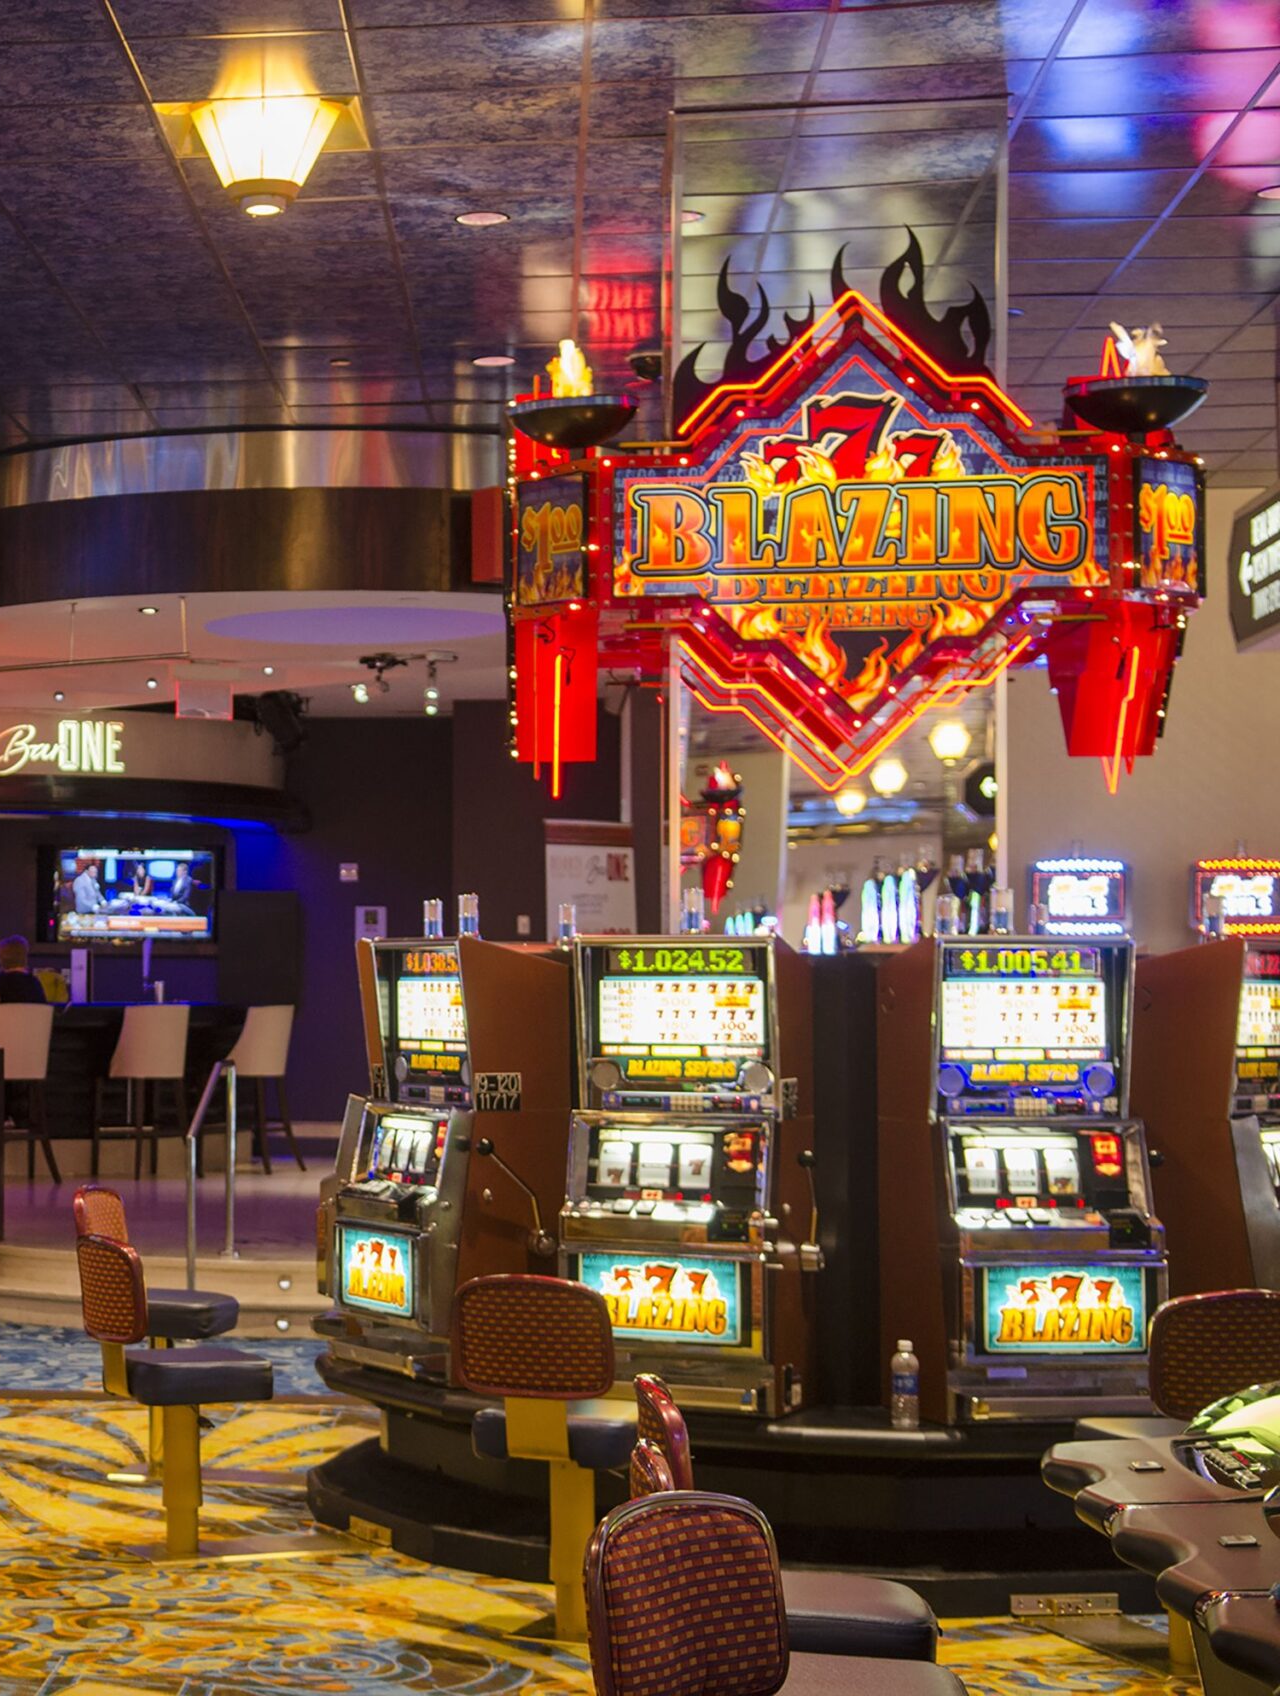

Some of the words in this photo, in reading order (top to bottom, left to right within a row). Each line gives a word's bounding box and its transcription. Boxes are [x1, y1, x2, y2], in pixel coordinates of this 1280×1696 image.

[631, 476, 1089, 576] BLAZING
[58, 720, 125, 772] ONE
[604, 1294, 726, 1335] BLAZING
[996, 1308, 1134, 1344] BLAZING
